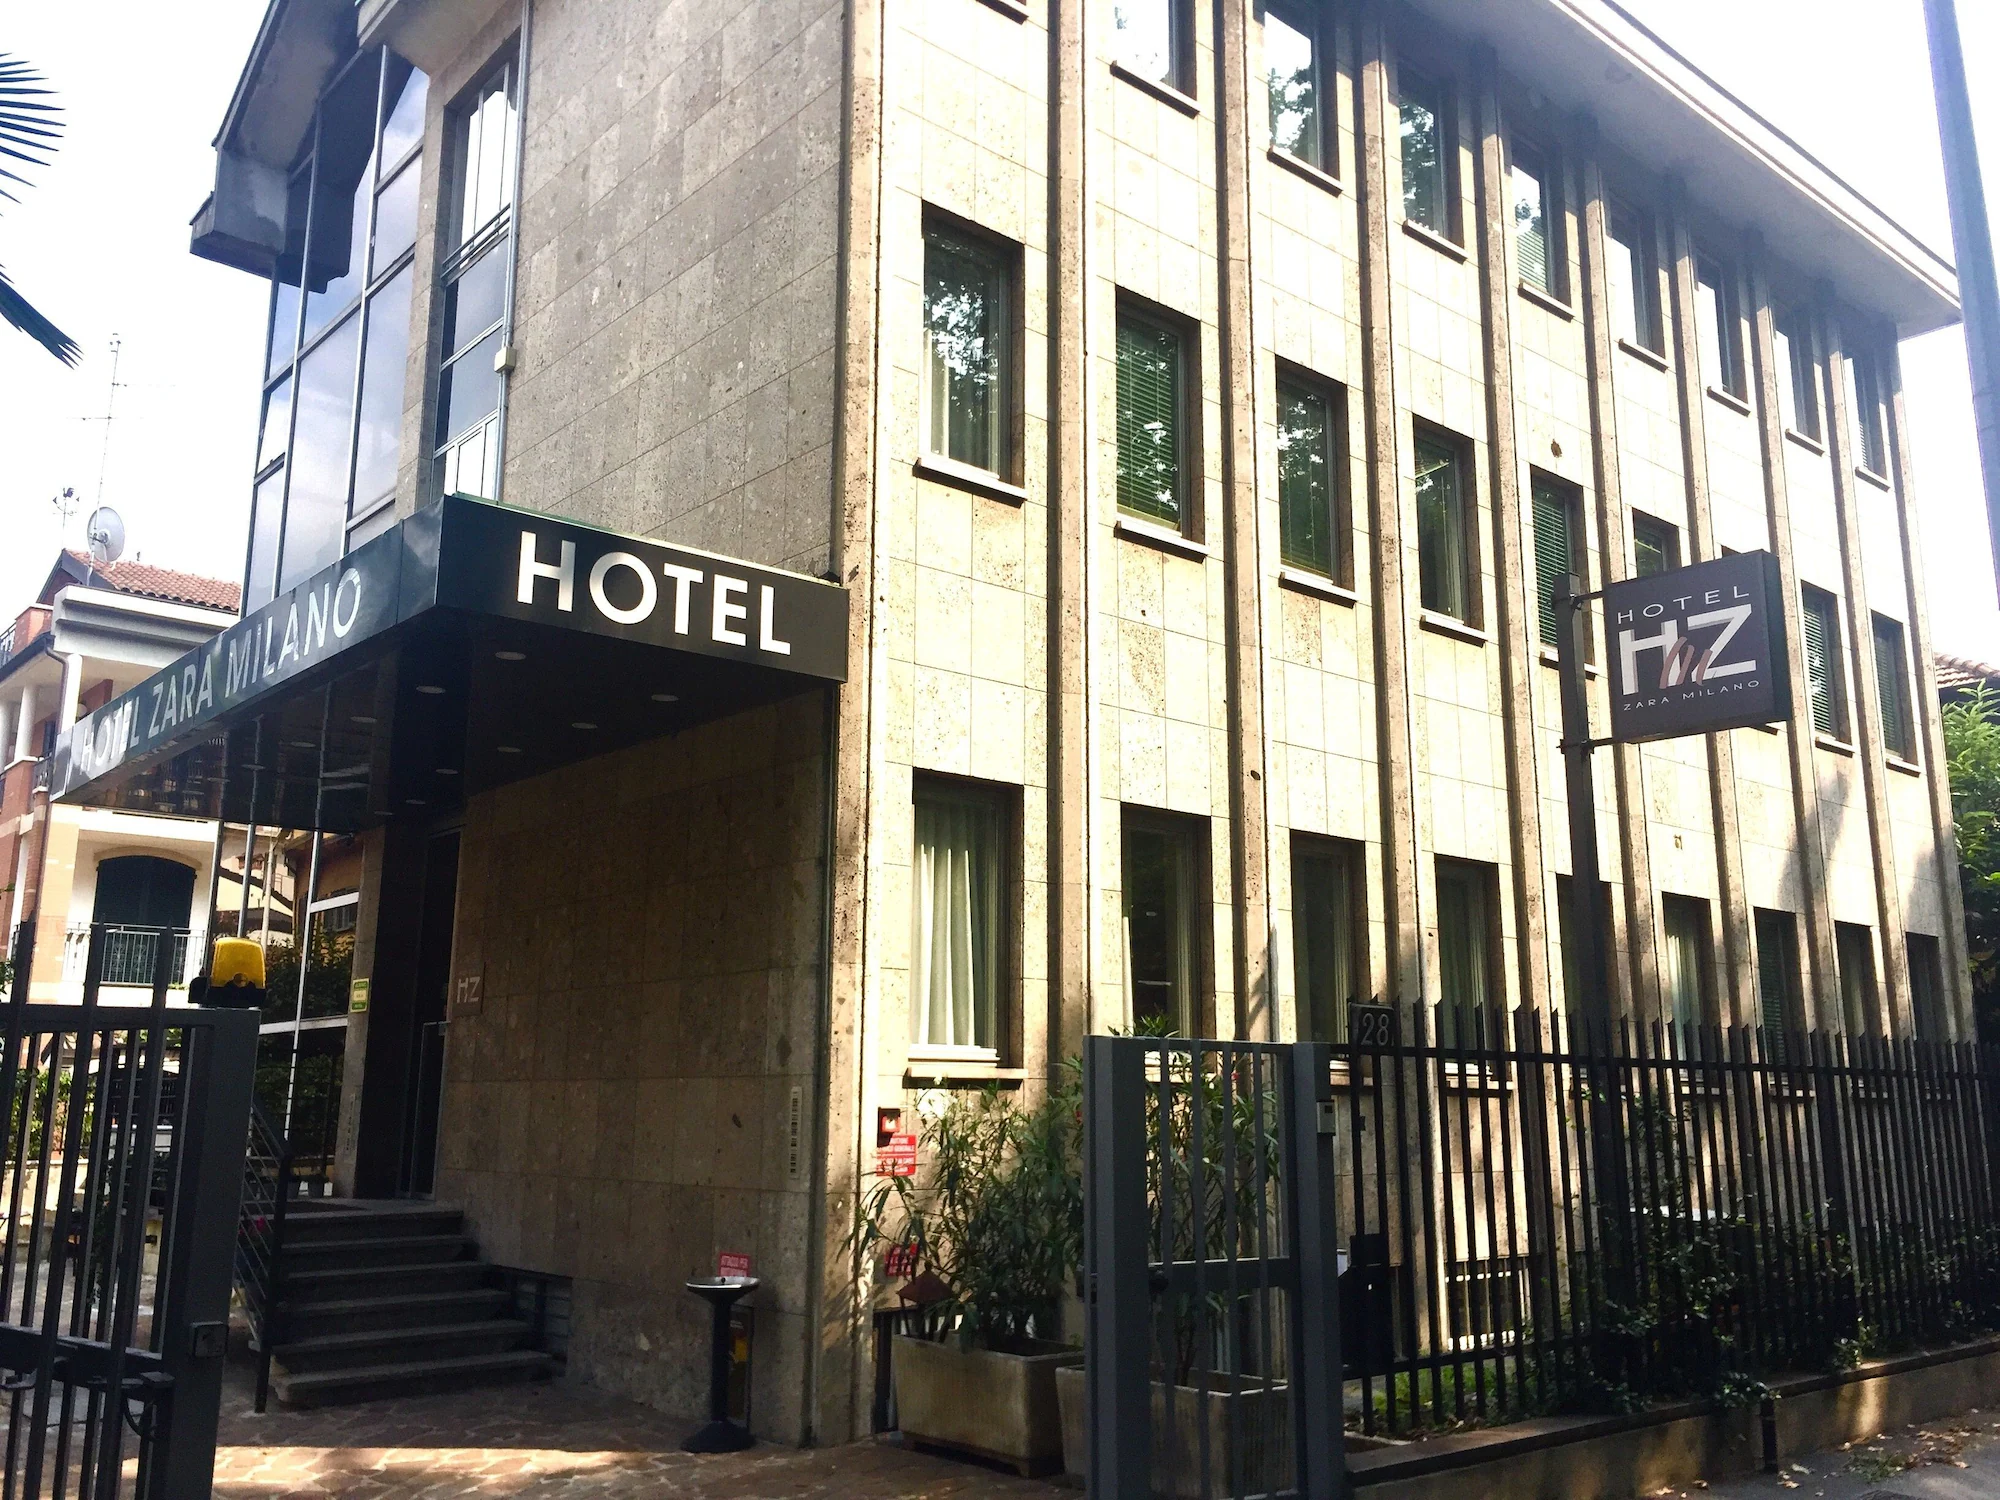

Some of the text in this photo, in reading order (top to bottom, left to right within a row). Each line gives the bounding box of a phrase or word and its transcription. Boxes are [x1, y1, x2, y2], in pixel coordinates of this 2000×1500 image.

[517, 531, 791, 656] HOTEL
[1617, 586, 1750, 624] HOTEL
[80, 568, 362, 775] HOTEL ZARA MILANO
[1623, 680, 1760, 711] ZARA MILANO
[456, 976, 481, 1003] HZ
[1360, 1013, 1389, 1046] 28
